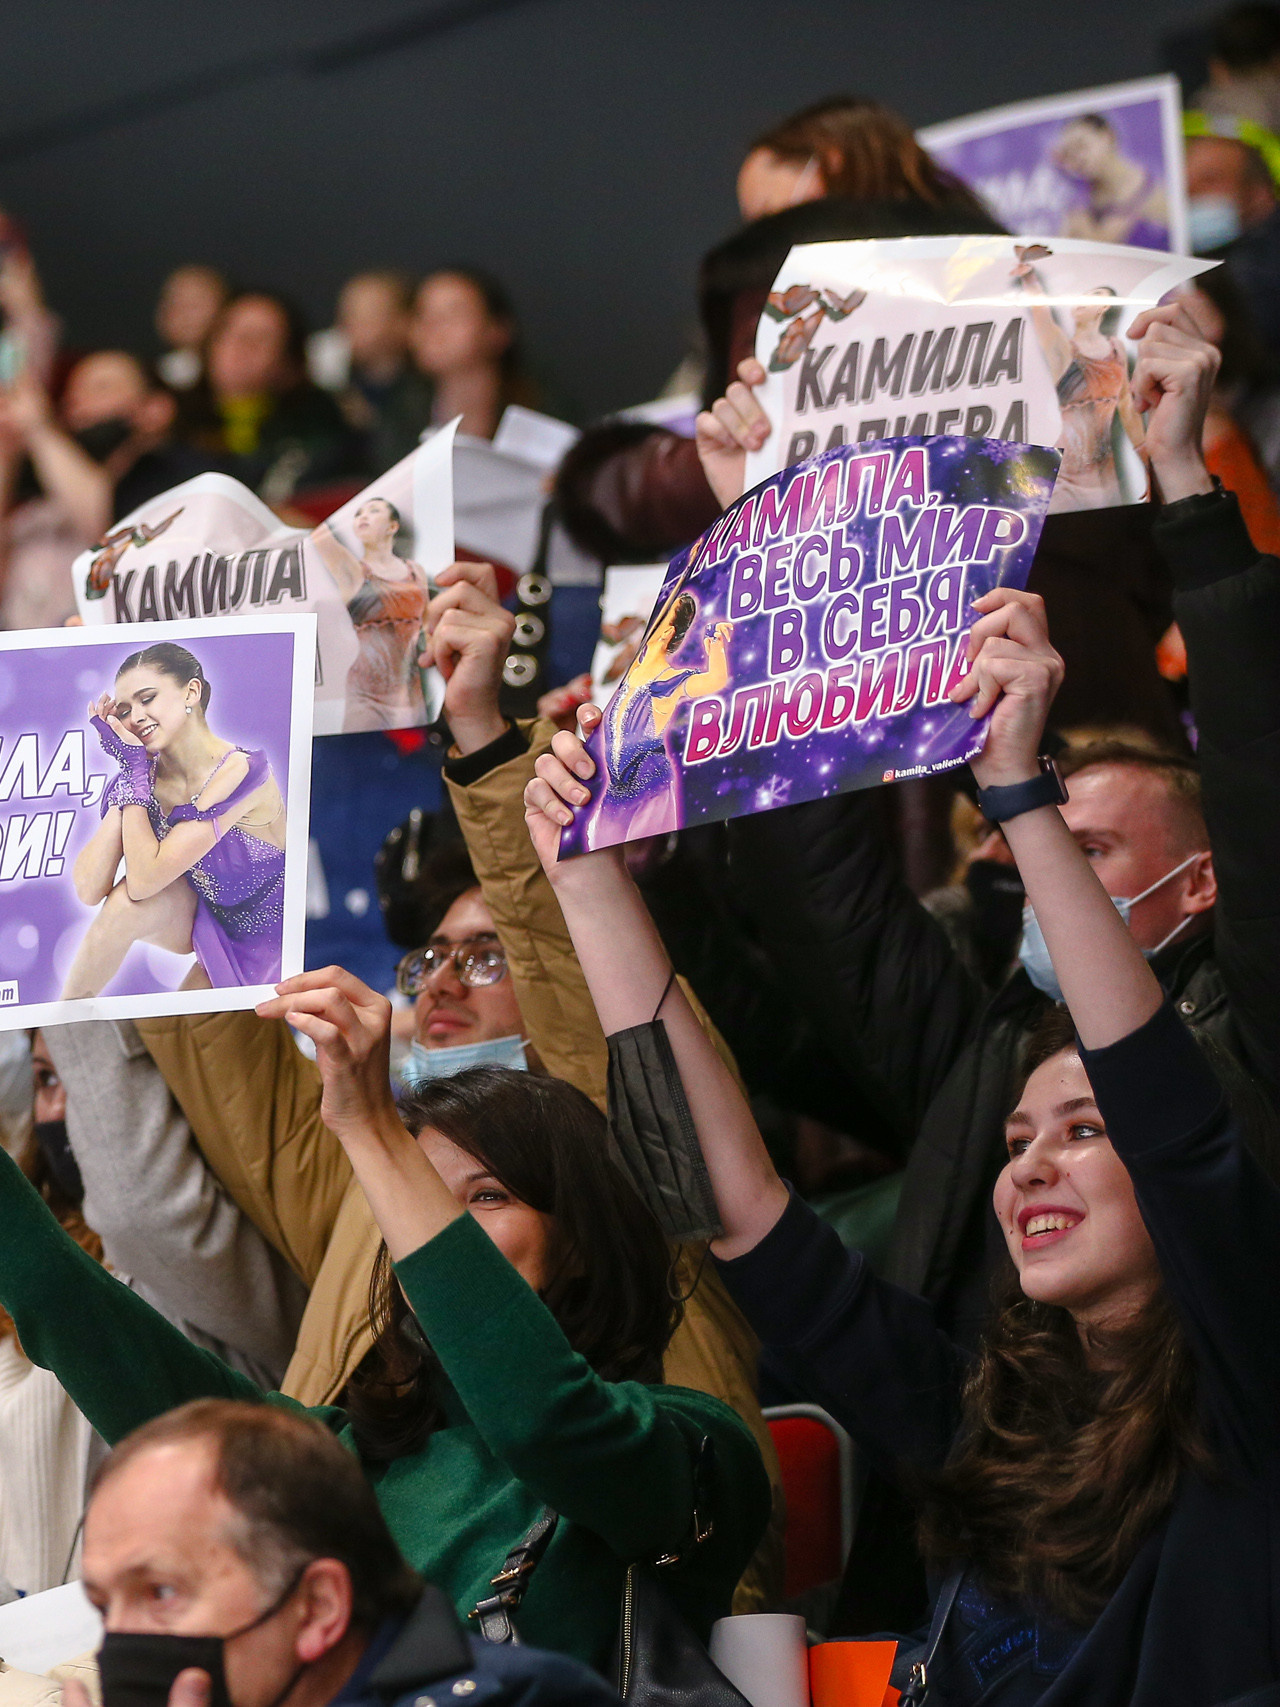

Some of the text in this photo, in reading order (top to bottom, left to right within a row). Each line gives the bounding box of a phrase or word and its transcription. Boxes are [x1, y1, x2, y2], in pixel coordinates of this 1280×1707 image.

[796, 318, 1027, 416] КАМИЛА
[113, 541, 307, 624] КАМИЛА
[729, 506, 1027, 622] ВЕСЬ МИР
[769, 565, 964, 679] В СЕБЯ
